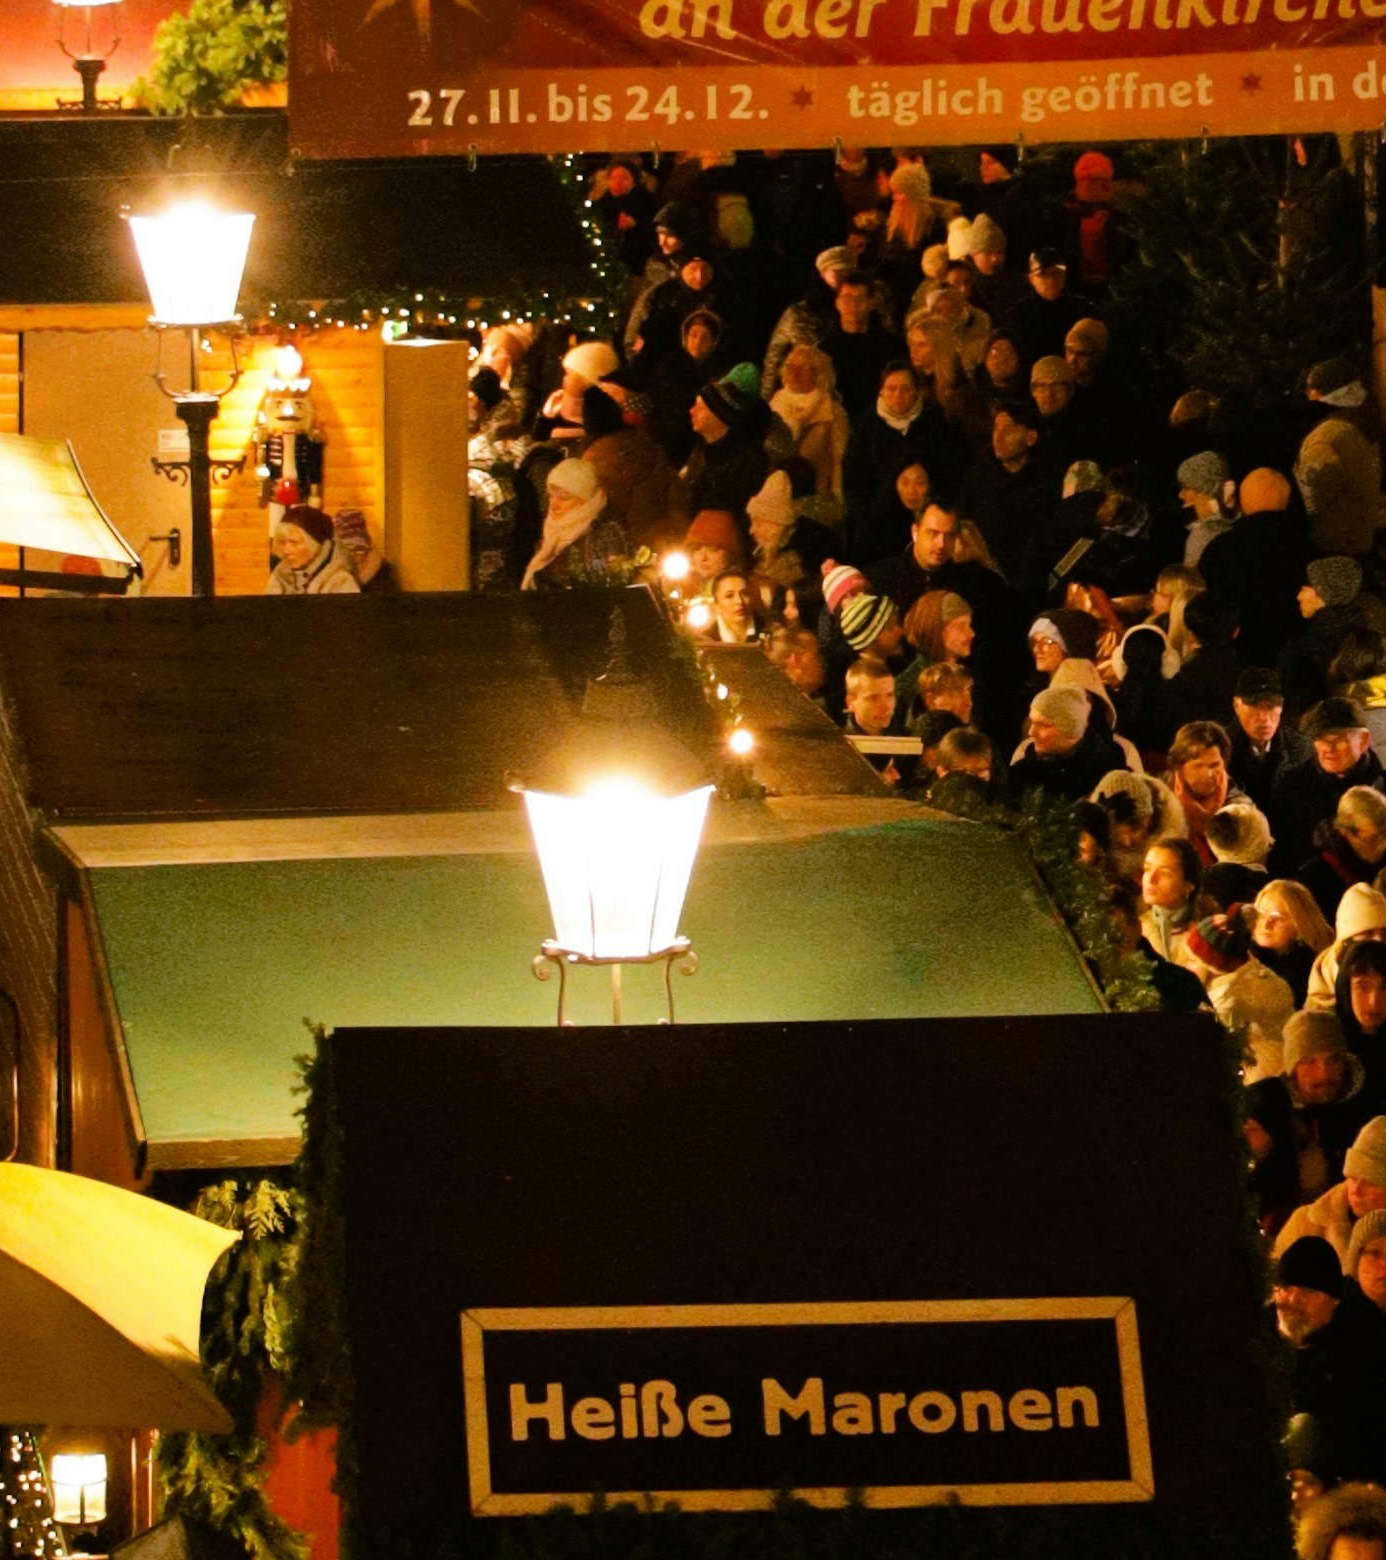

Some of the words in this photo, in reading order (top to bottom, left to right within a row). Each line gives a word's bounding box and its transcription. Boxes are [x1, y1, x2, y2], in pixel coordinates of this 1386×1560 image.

[547, 82, 613, 124] bis
[624, 83, 770, 126] 24.12.
[847, 76, 1004, 126] täglich
[1020, 73, 1215, 125] geöffnet
[1291, 61, 1341, 102] in
[509, 1378, 732, 1443] Heiße
[761, 1376, 1100, 1437] Maronen
